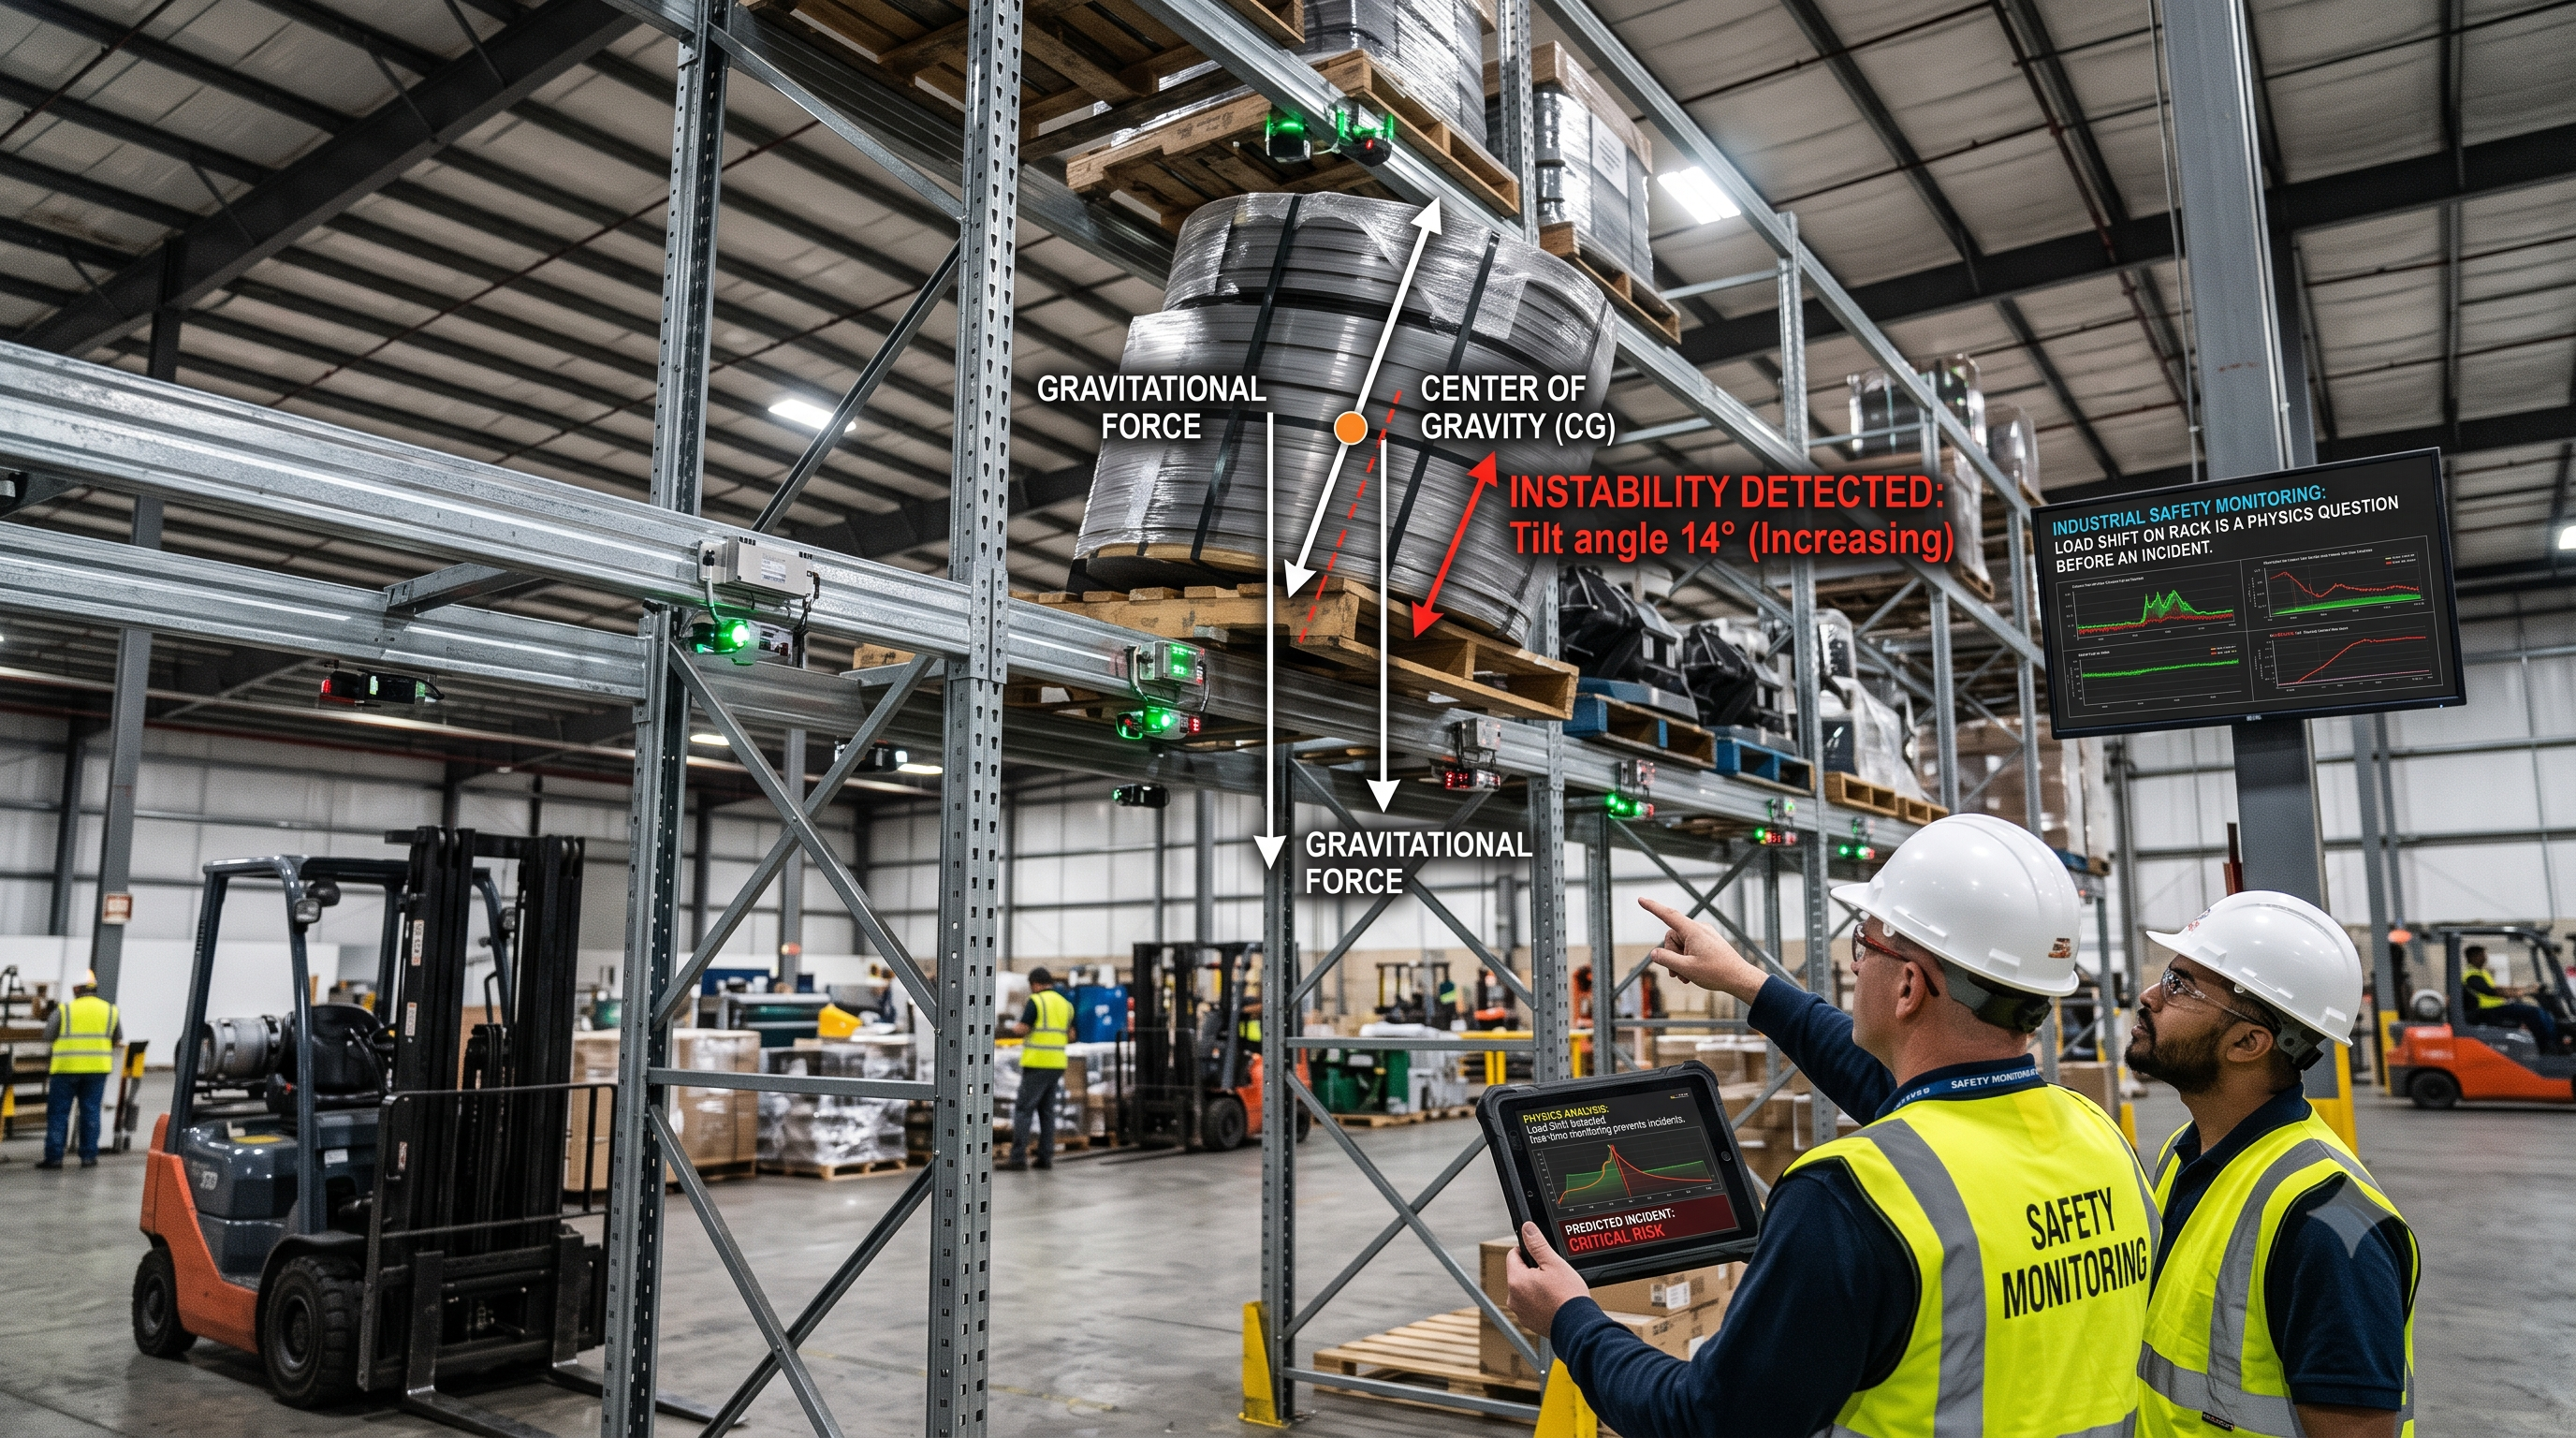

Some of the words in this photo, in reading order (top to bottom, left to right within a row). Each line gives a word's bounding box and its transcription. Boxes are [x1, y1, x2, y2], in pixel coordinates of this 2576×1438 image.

[2052, 509, 2146, 536] INDUSTRIAL
[2149, 499, 2212, 523] SAFETY
[2215, 484, 2327, 514] MONITORING:
[2055, 536, 2094, 555] LOAD
[2098, 530, 2140, 549] SHIFT
[2143, 526, 2165, 543] ON
[2169, 520, 2212, 539] RACK
[2215, 518, 2230, 534] IS
[2232, 516, 2245, 531] A
[2247, 506, 2314, 529] PHYSICS
[2318, 494, 2400, 520] QUESTION
[2056, 552, 2115, 574] BEFORE
[2117, 549, 2138, 565] AN
[2142, 539, 2214, 562] INCIDENT.
[1951, 1077, 1989, 1090] SAFETY
[1523, 1111, 1562, 1123] PHYSICS
[1564, 1105, 1610, 1118] ANALYSIS:
[1612, 1121, 1647, 1135] prevents
[1647, 1115, 1686, 1128] incidents.
[1526, 1123, 1548, 1135] Load
[1565, 1217, 1623, 1235] PREDICTED
[1625, 1208, 1676, 1225] INCIDENT:
[2026, 1186, 2115, 1251] SAFETY
[1569, 1229, 1632, 1252] CRITICAL
[1632, 1224, 1666, 1241] RISK
[2001, 1236, 2147, 1320] MONITORING
